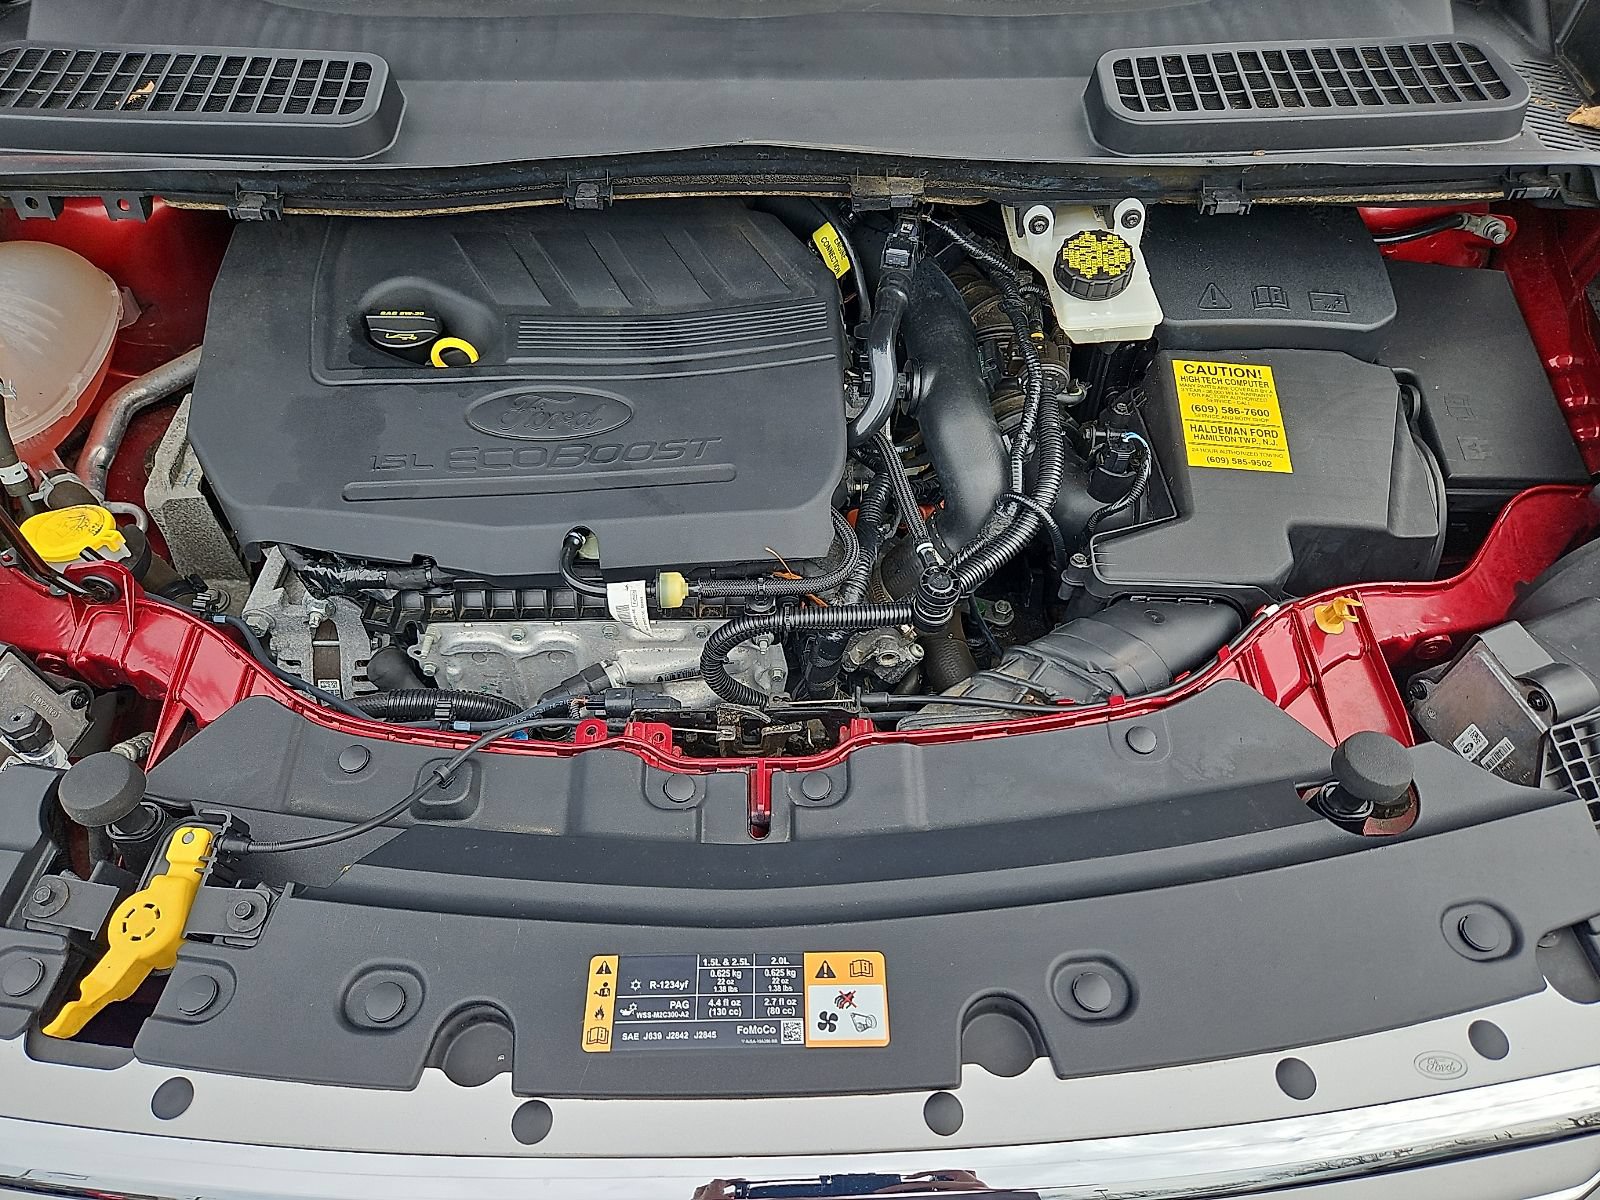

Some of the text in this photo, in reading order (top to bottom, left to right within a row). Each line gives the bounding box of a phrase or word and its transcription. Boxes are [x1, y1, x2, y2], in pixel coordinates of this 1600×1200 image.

[820, 236, 842, 275] CONNECTION
[1184, 364, 1262, 378] CAUTION!
[1225, 378, 1270, 388] COMPUTER
[500, 393, 603, 431] Ford
[1191, 404, 1270, 417] (609) 586-7600
[1189, 424, 1279, 438] HALDEMAN FORD
[1193, 433, 1236, 442] HAMILTON
[1206, 456, 1272, 467] (609) 585-9502
[703, 958, 750, 966] 1.5L & 2.5L
[770, 956, 790, 965] 2.0L
[710, 969, 742, 979] 0.625 kg
[764, 968, 796, 978] 0.625 kg
[649, 980, 690, 990] R-1234yf
[670, 1000, 690, 1009] PAG
[708, 998, 722, 1007] 4.4
[722, 998, 730, 1006] fl
[764, 998, 777, 1006] 2.7
[778, 998, 785, 1006] fl
[708, 1006, 742, 1017] (130 cc)
[766, 1006, 796, 1016] (80 cc)
[736, 1024, 776, 1034] FoMoCo
[622, 1032, 640, 1041] SAE
[666, 1031, 689, 1040] J2842
[694, 1030, 717, 1040] J2845
